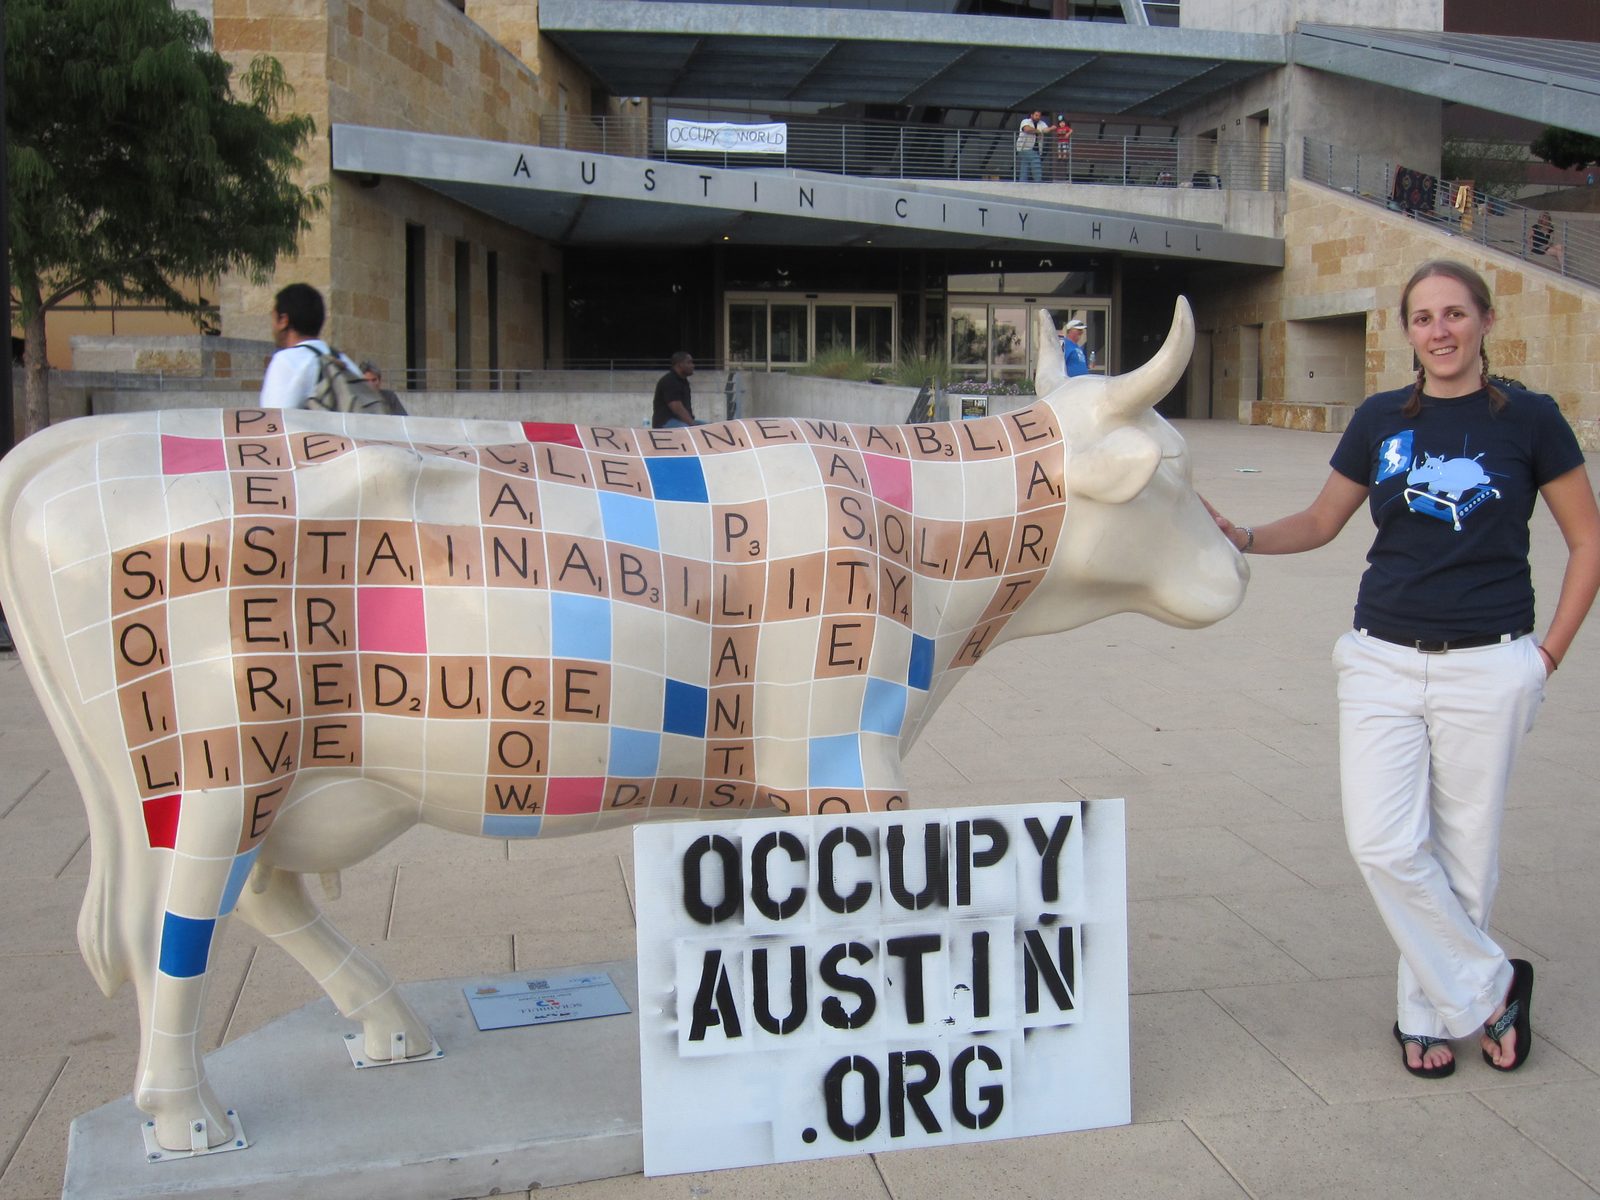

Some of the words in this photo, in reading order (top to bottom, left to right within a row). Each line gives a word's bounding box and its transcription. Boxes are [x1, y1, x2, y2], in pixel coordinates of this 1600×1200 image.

[670, 127, 718, 145] OCCUPY
[737, 131, 784, 145] WORLD
[513, 153, 814, 209] AUSTIN
[895, 198, 1028, 232] CITY
[1092, 222, 1202, 251] HALL
[238, 434, 642, 492] REYCLE
[682, 815, 1074, 925] OCCUPY
[688, 926, 1076, 1041] AUSTIN
[802, 1045, 1004, 1142] .ORG
